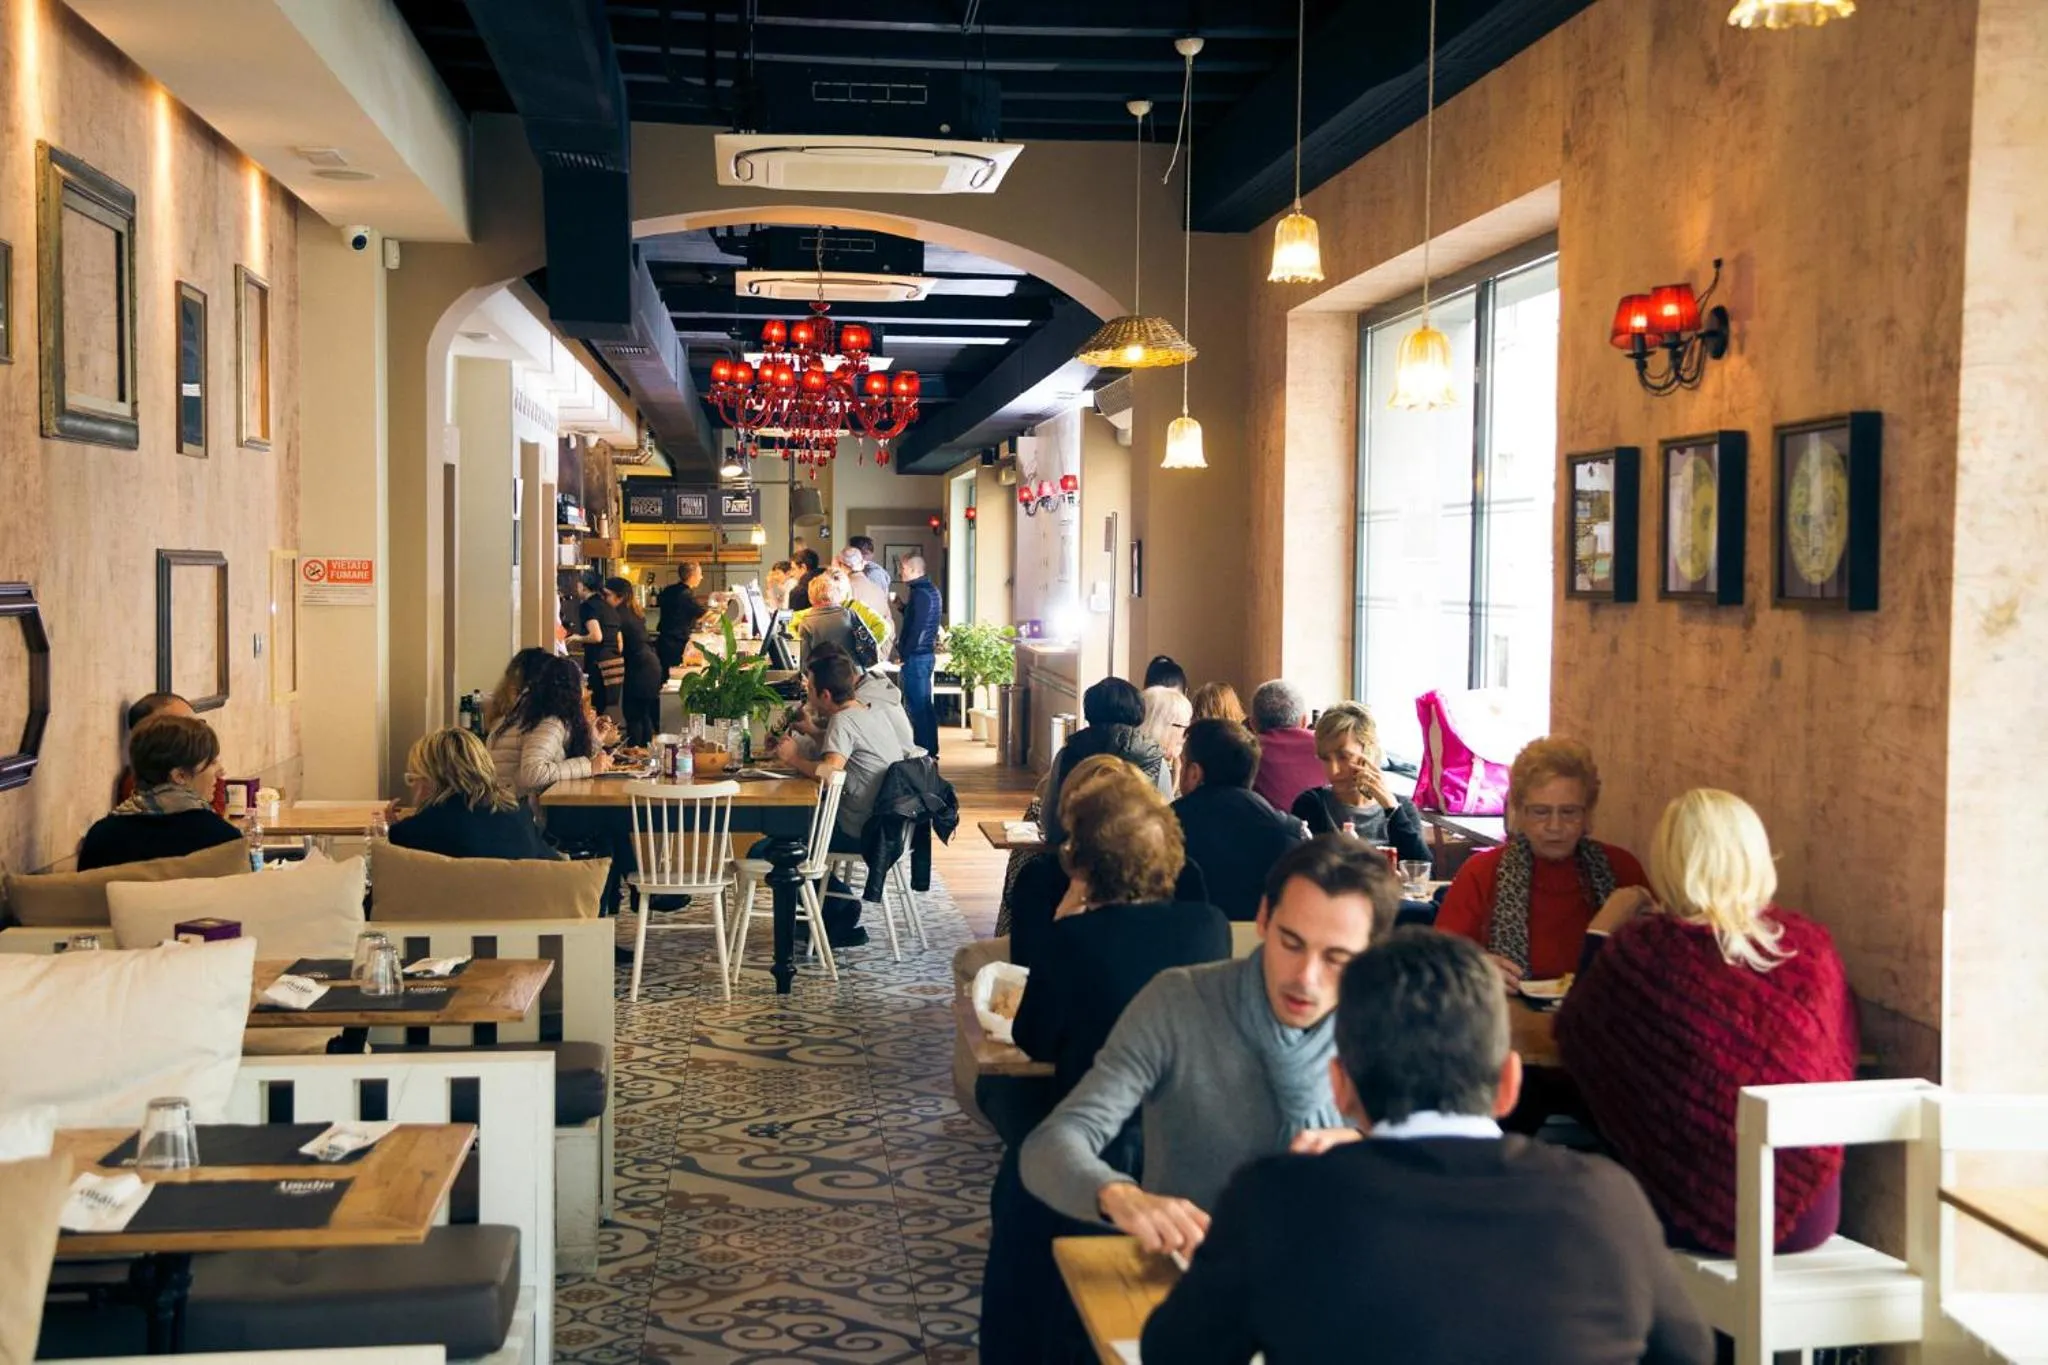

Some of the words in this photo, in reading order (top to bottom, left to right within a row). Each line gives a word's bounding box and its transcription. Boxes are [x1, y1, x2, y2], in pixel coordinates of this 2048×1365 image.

[725, 499, 749, 513] PANE
[331, 560, 369, 570] VIETATO
[330, 571, 370, 580] FUMARE
